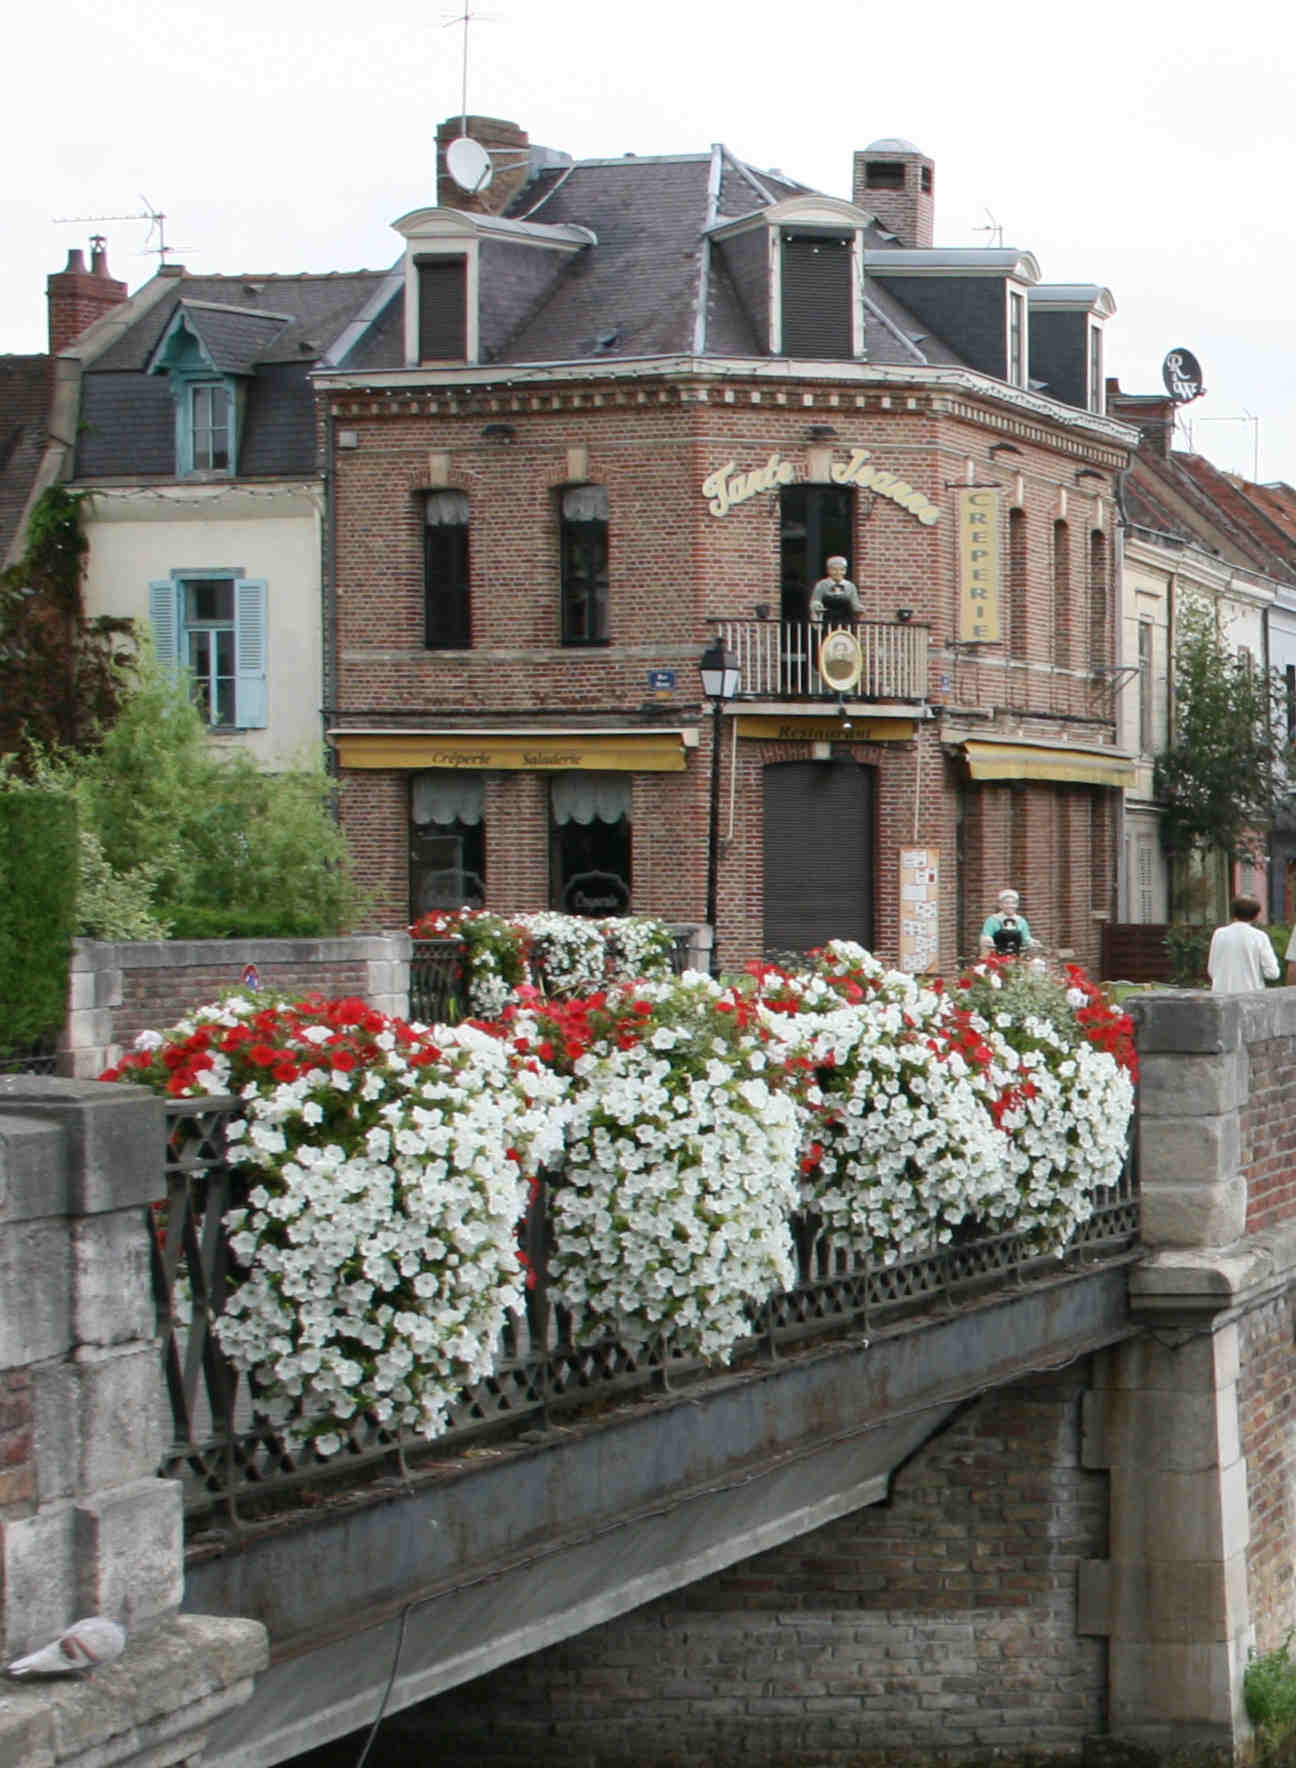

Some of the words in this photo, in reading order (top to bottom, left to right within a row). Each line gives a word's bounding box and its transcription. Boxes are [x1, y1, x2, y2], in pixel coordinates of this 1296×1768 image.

[702, 454, 795, 518] Tante
[831, 448, 941, 526] Jeanne
[967, 493, 993, 638] CREPERIE
